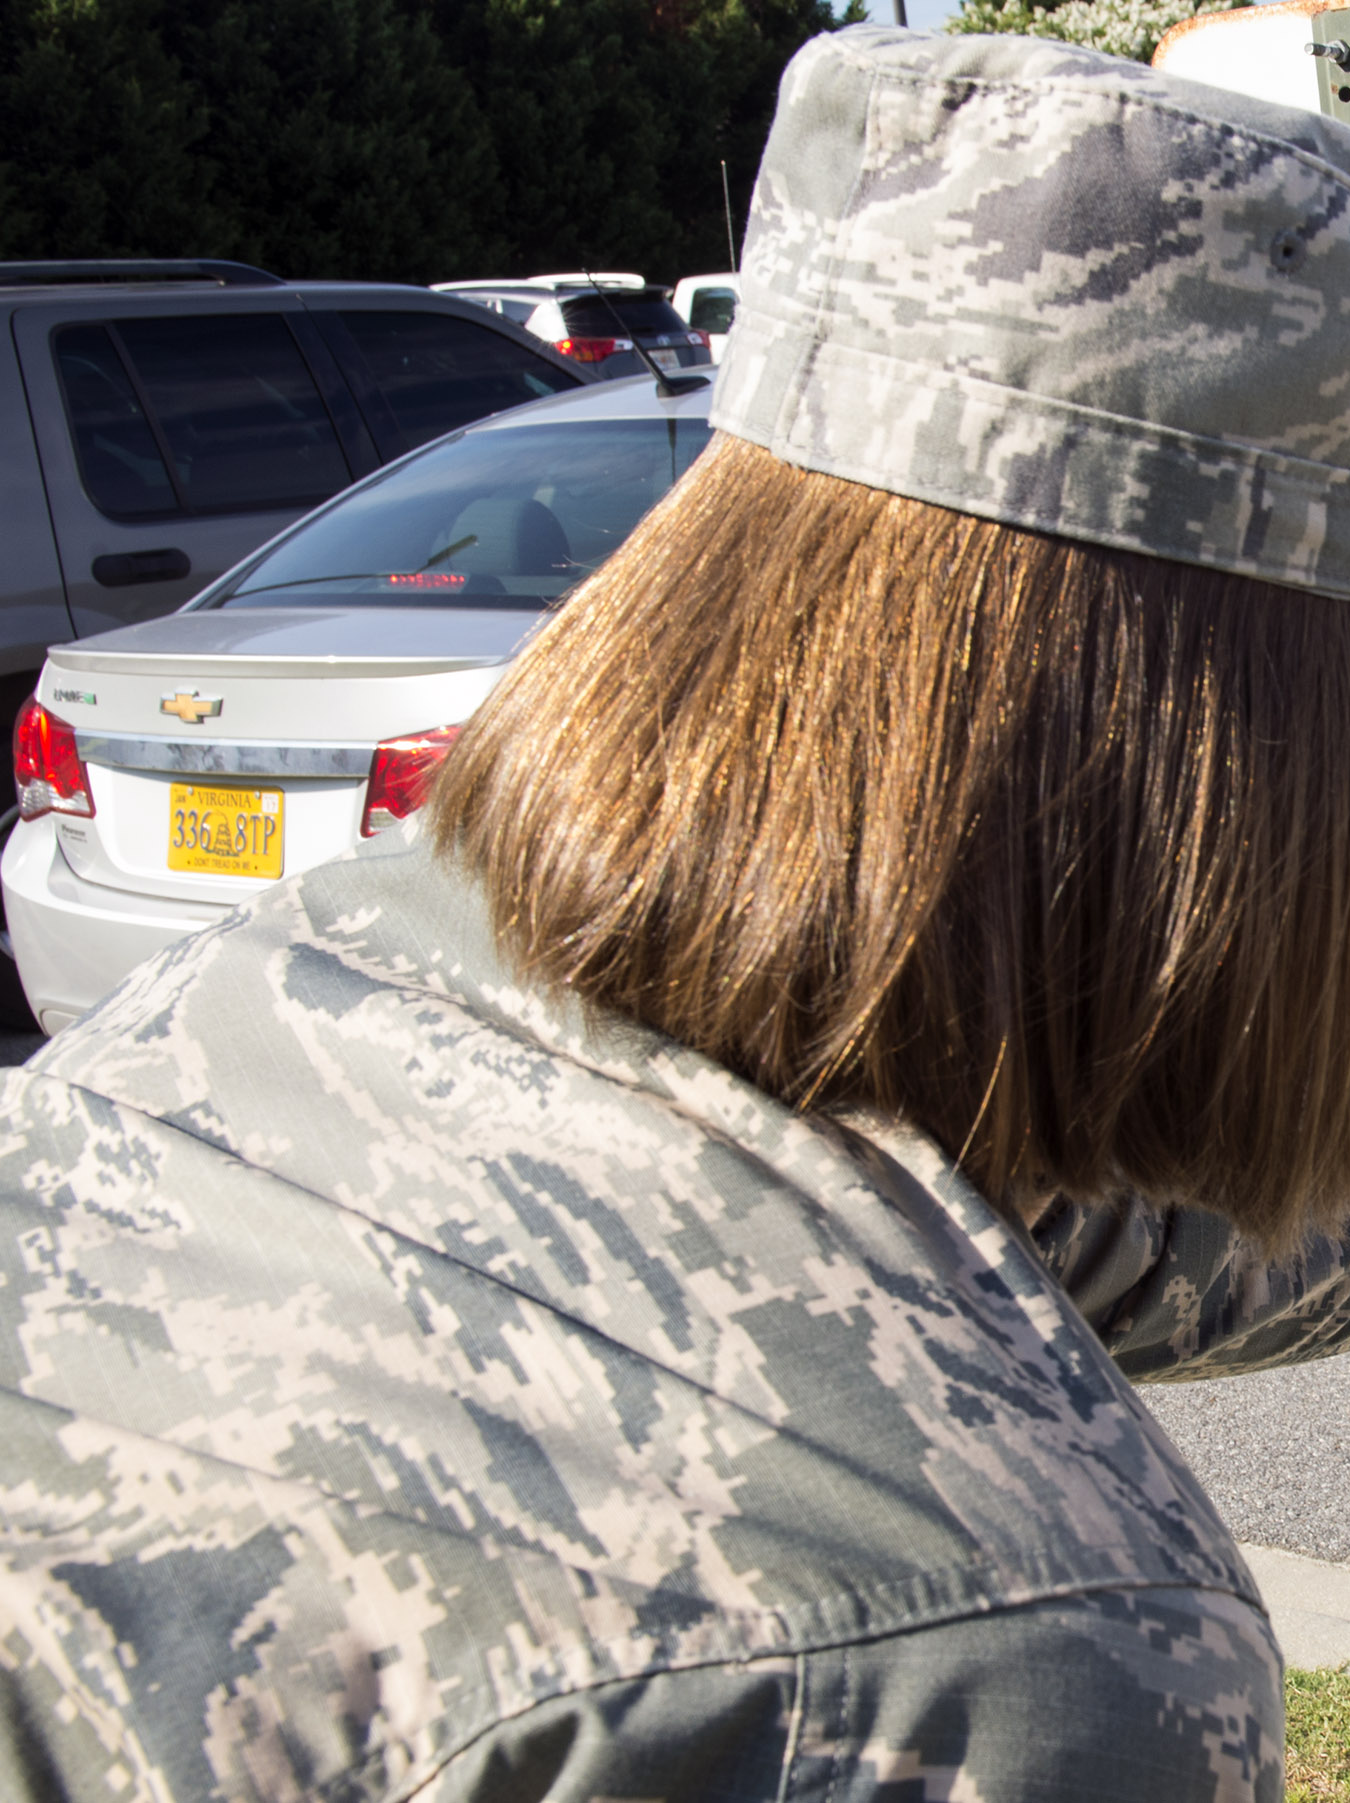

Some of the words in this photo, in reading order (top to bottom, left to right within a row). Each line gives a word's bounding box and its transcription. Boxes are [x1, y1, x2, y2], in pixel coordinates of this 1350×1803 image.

[197, 791, 251, 808] VIRGINIA
[173, 809, 212, 850] 336
[235, 813, 276, 855] 8TP
